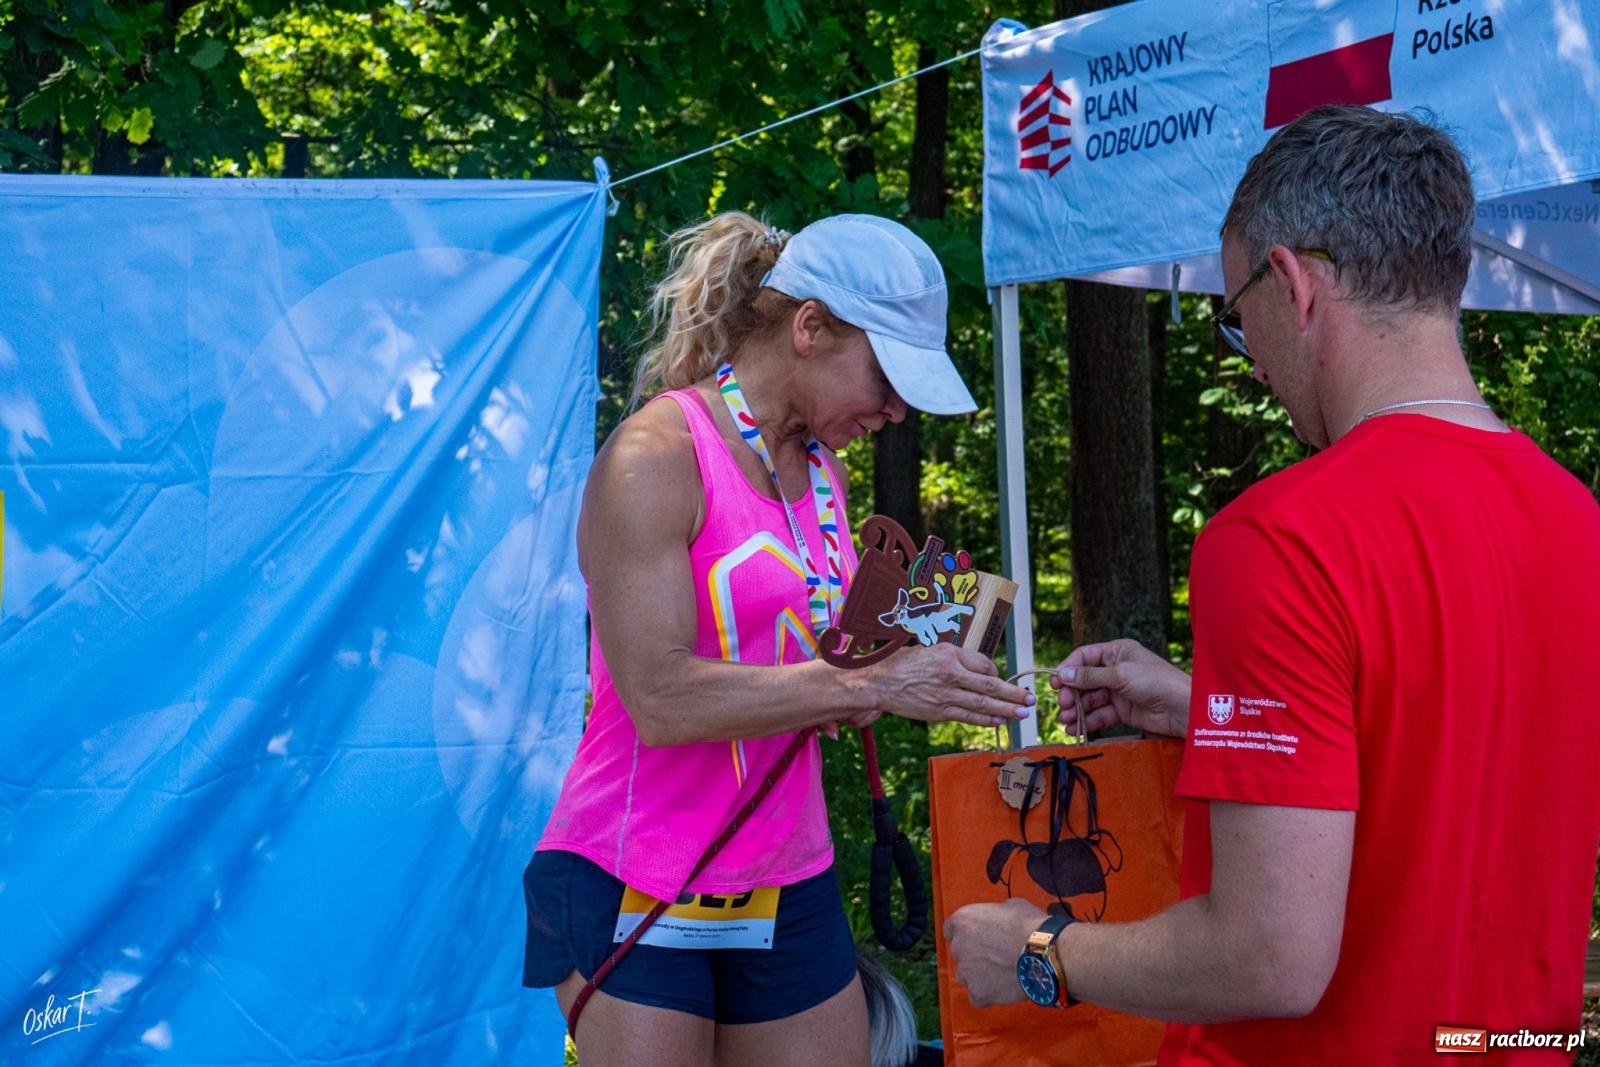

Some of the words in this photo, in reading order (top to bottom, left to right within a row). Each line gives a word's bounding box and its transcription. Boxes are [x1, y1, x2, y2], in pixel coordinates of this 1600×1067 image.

[1413, 12, 1494, 59] Polska
[1088, 32, 1187, 87] KRAJOWY
[1085, 85, 1138, 124] PLAN
[1086, 104, 1217, 161] ODBUDOWY
[1239, 697, 1287, 709] Województwo
[1239, 706, 1262, 716] Śląskie
[1194, 739, 1226, 748] Samorządu
[1266, 742, 1297, 754] Śląskiego
[1271, 733, 1299, 744] budżetu
